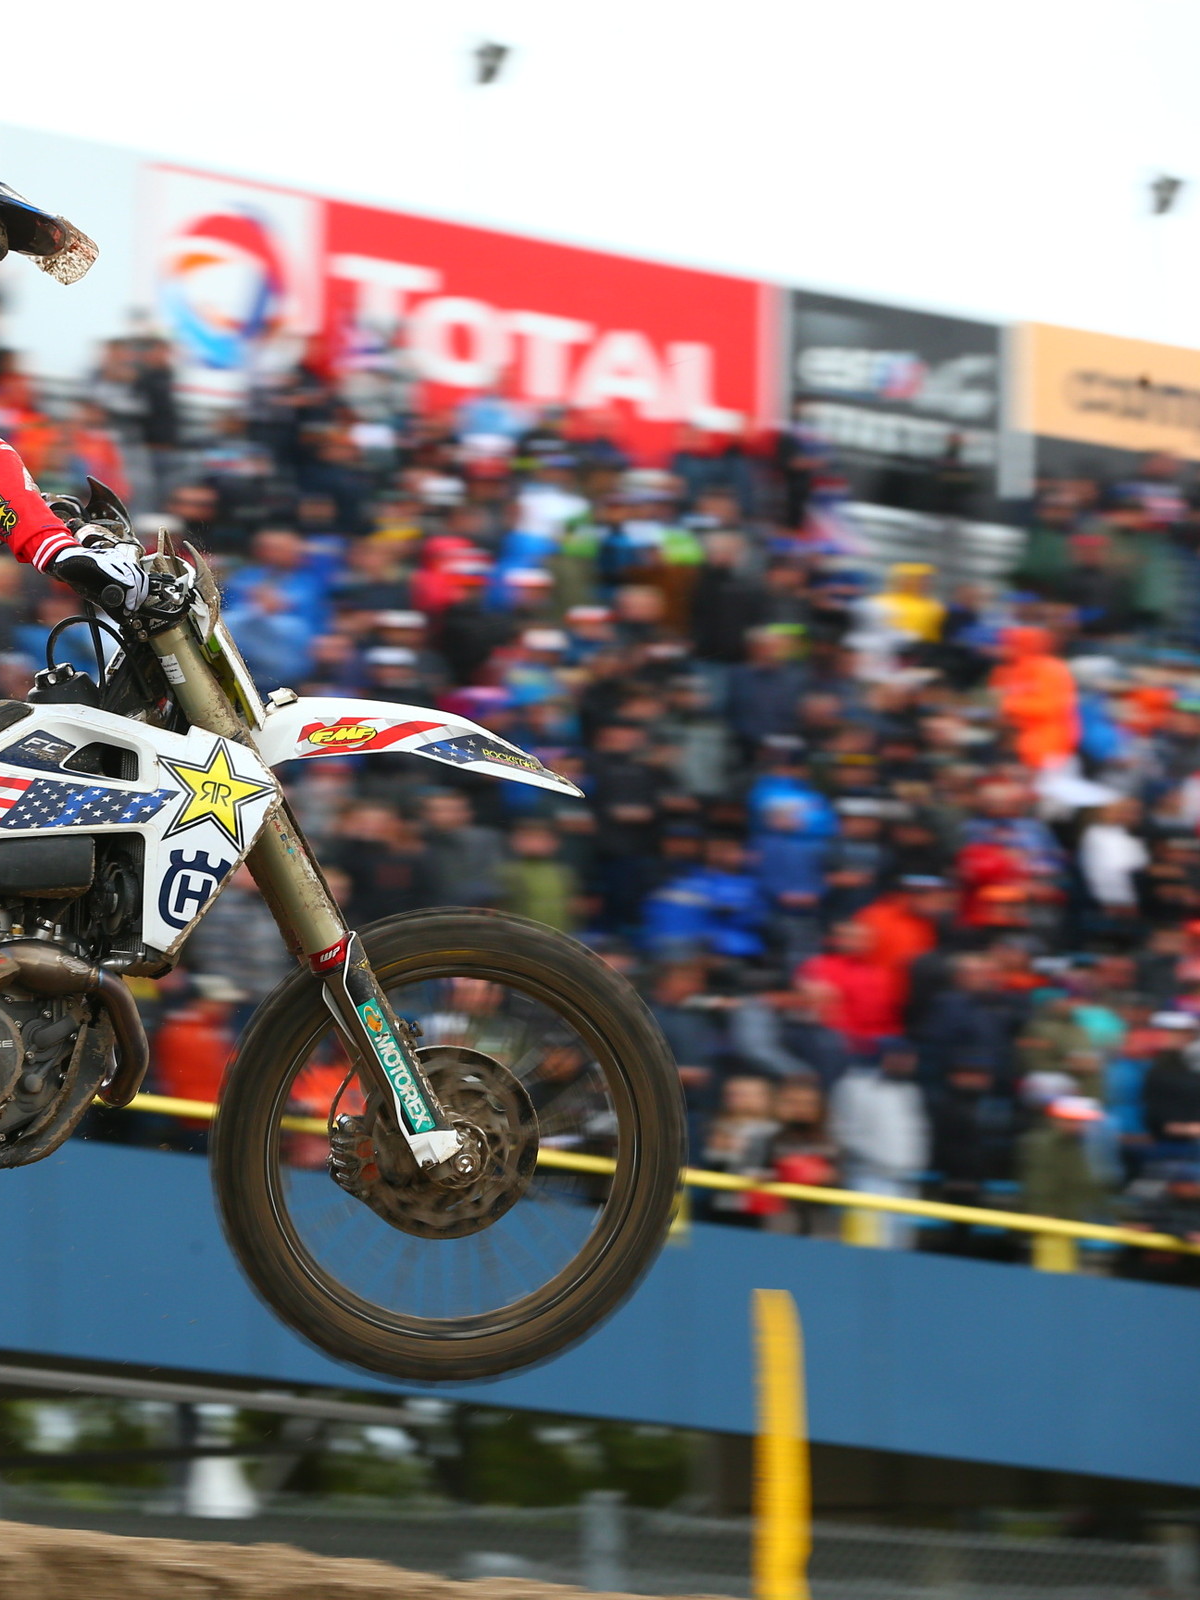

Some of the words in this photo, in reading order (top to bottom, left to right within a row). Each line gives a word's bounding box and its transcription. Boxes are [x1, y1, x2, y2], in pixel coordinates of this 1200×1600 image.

[328, 252, 748, 434] TOTAL
[310, 727, 376, 744] FMF
[319, 945, 341, 963] WP
[374, 1031, 434, 1130] MOTOREX
